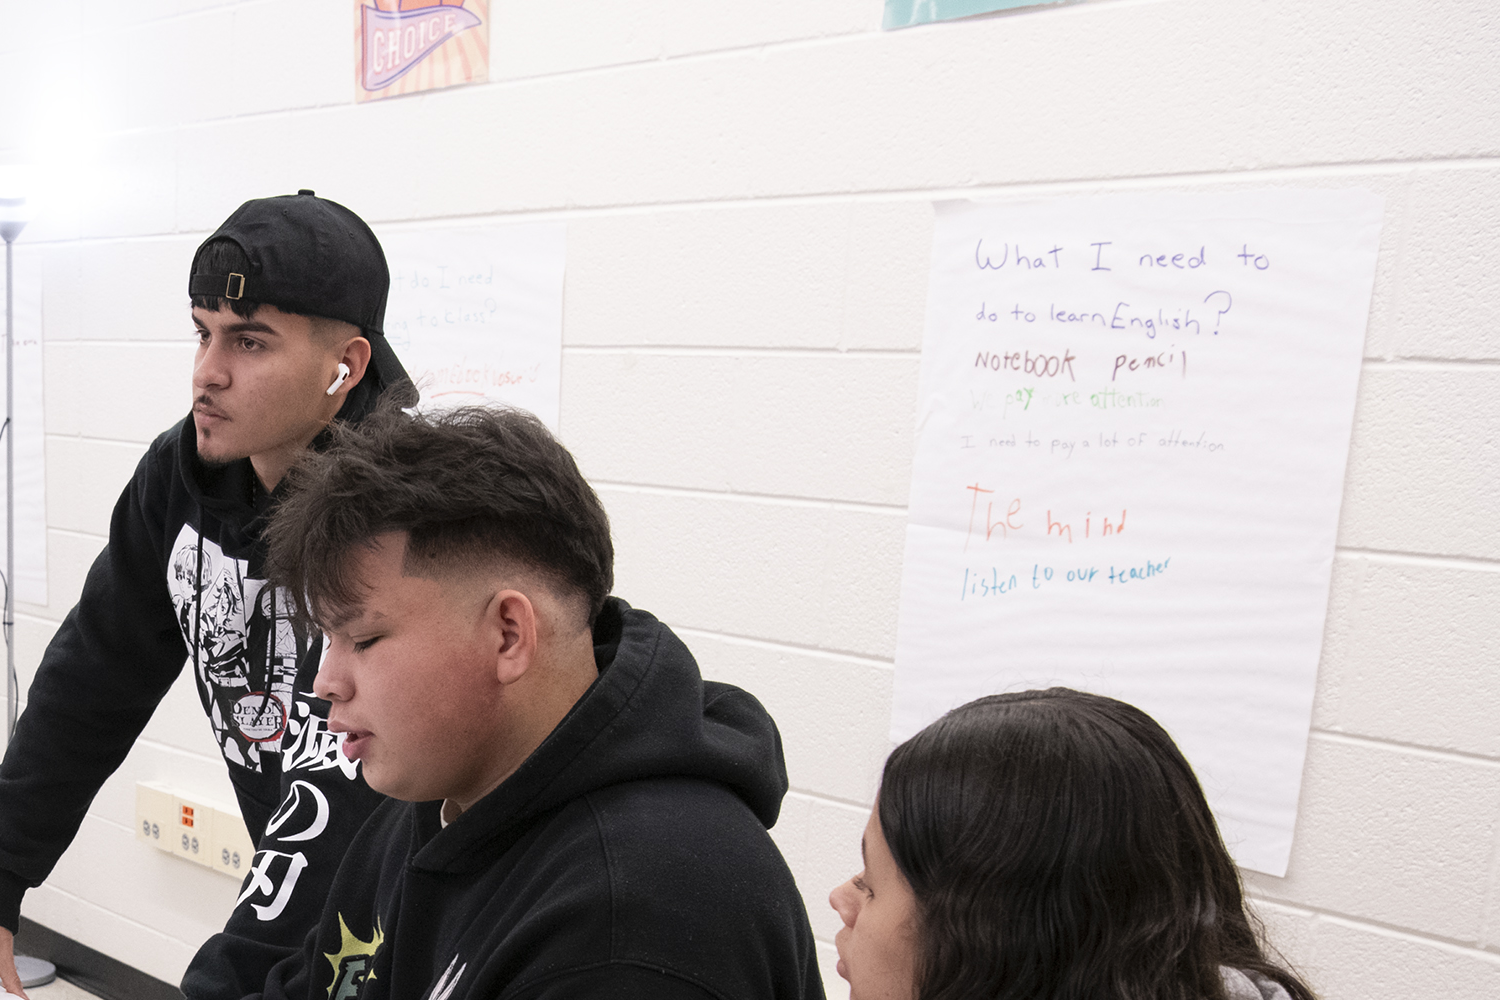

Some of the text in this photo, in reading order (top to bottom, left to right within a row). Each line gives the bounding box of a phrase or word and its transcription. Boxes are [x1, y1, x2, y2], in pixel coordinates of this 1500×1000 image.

[372, 13, 457, 75] CHOICE
[975, 239, 1270, 271] What I need to
[411, 271, 429, 288] do
[437, 265, 450, 289] I
[458, 265, 494, 285] need
[416, 309, 438, 327] to
[976, 290, 1232, 338] do to learn English?
[1004, 387, 1035, 419] pay
[1089, 388, 1166, 410] attention
[961, 435, 975, 450] I
[990, 433, 1017, 449] need
[1025, 430, 1041, 450] to
[1051, 436, 1079, 460] pay
[1082, 439, 1091, 450] a
[1098, 432, 1119, 450] lot
[1159, 429, 1225, 453] attention
[963, 482, 1127, 554] The mind
[961, 556, 1171, 601] listen to our teacher
[228, 699, 284, 717] DEMON
[231, 715, 286, 731] SLAYER
